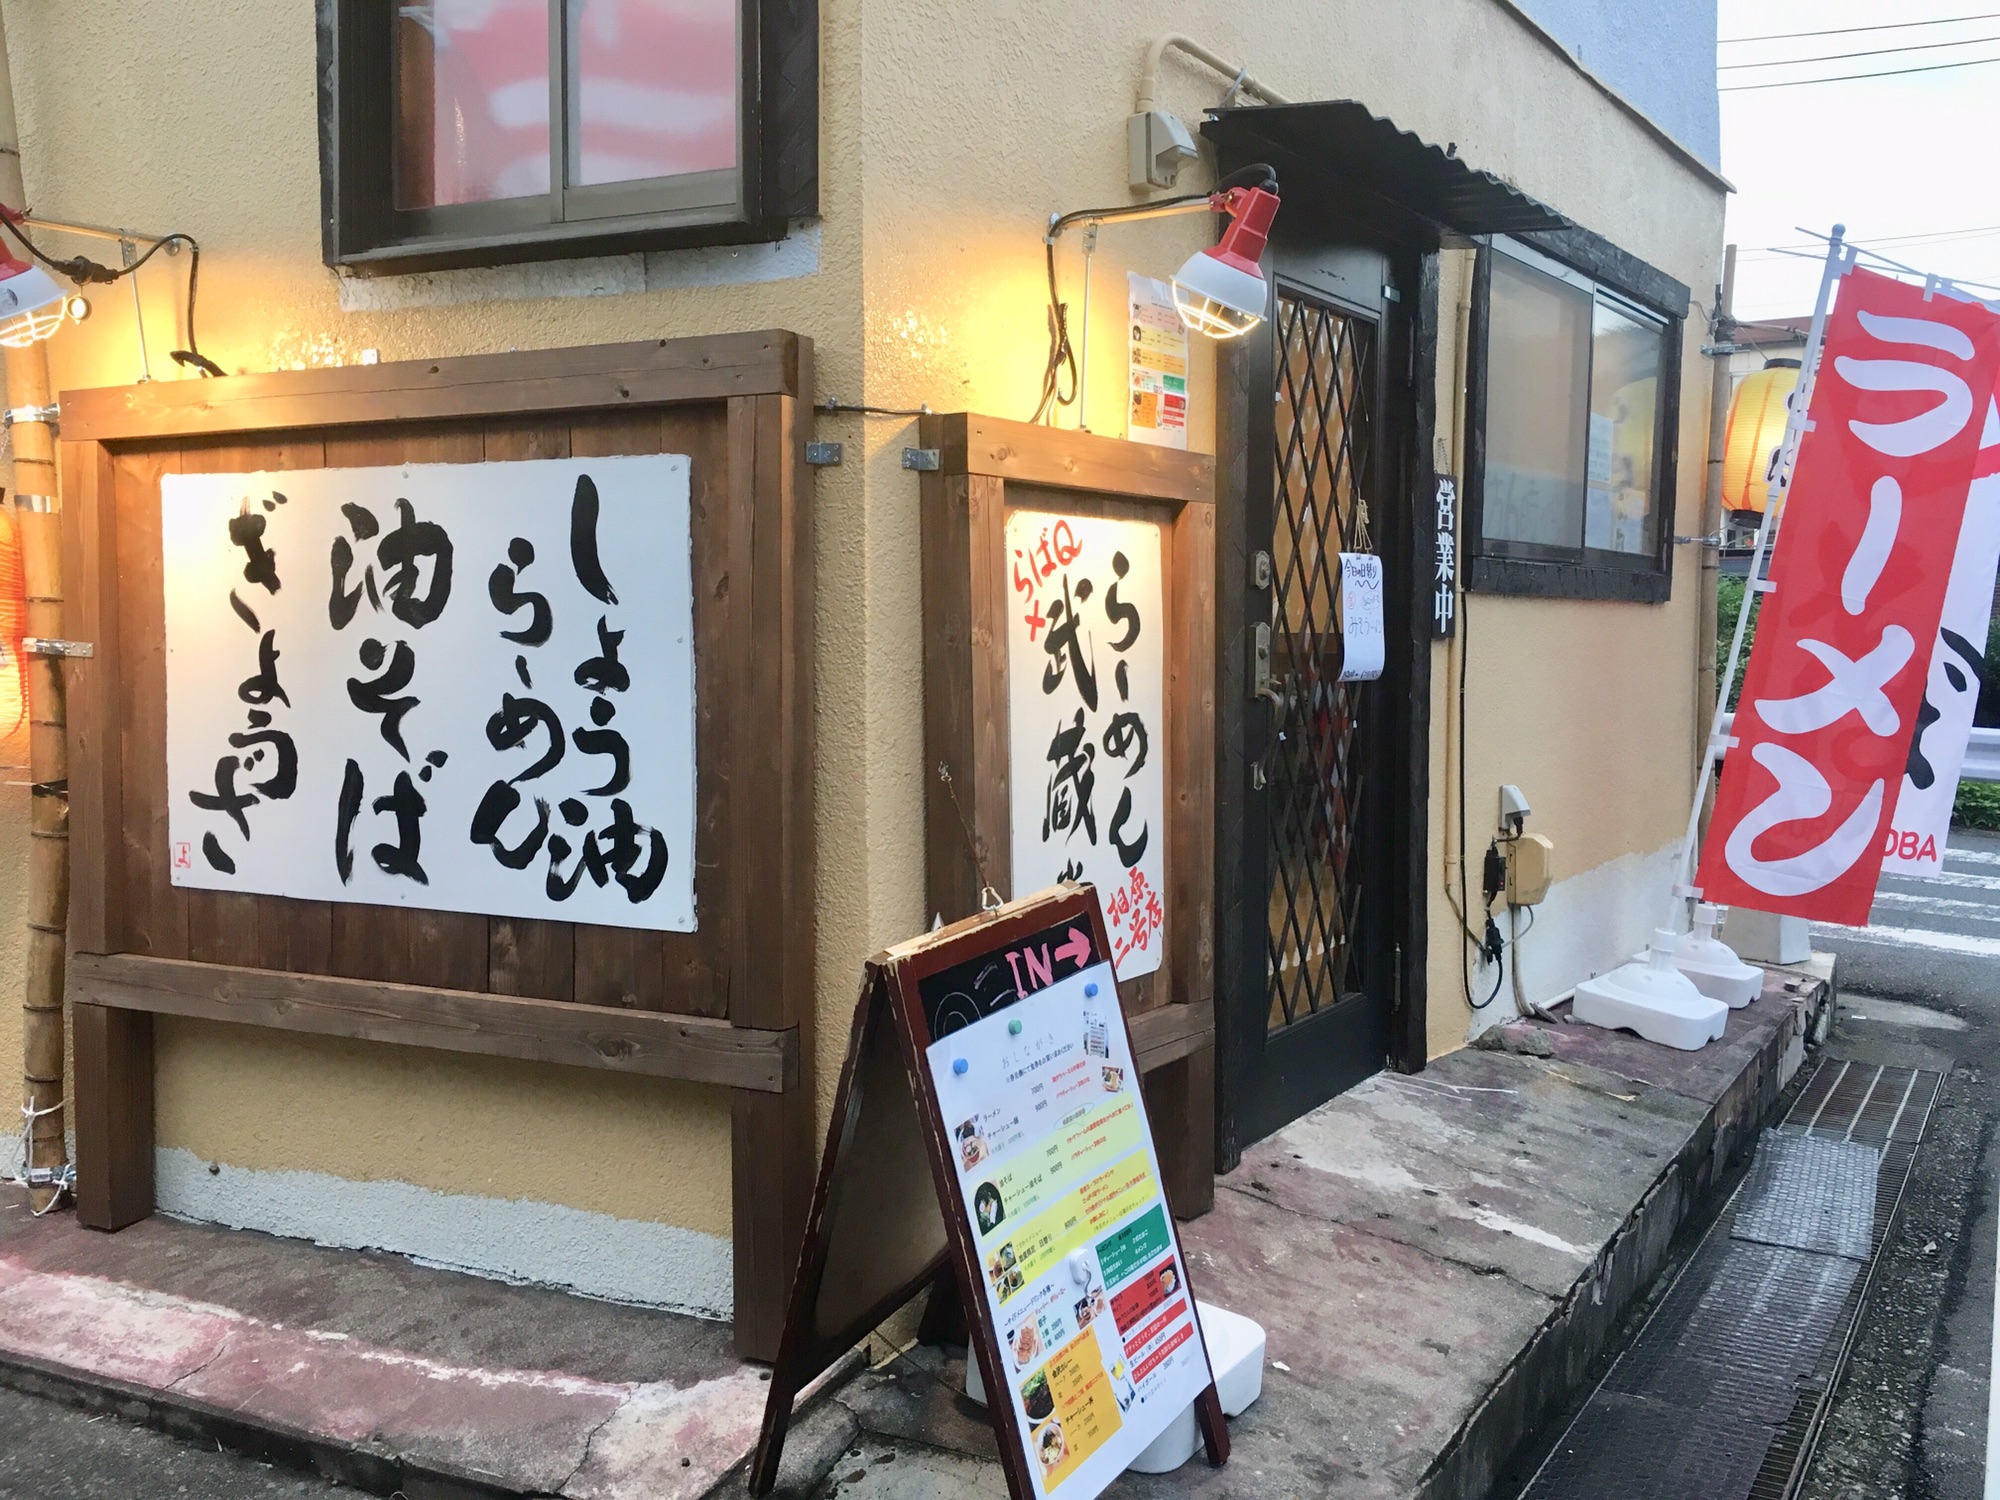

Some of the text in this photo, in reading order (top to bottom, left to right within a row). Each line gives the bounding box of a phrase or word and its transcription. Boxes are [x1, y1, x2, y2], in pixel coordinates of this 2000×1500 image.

[189, 490, 299, 876] ぎょうざ
[329, 497, 454, 887] 油そば
[470, 537, 566, 870] らーめん
[1104, 550, 1150, 869] らーめん
[1434, 478, 1456, 634] 営業中
[1725, 309, 1976, 896] ラーメン
[983, 1108, 1001, 1122] ラーメン
[1004, 943, 1054, 999] IN
